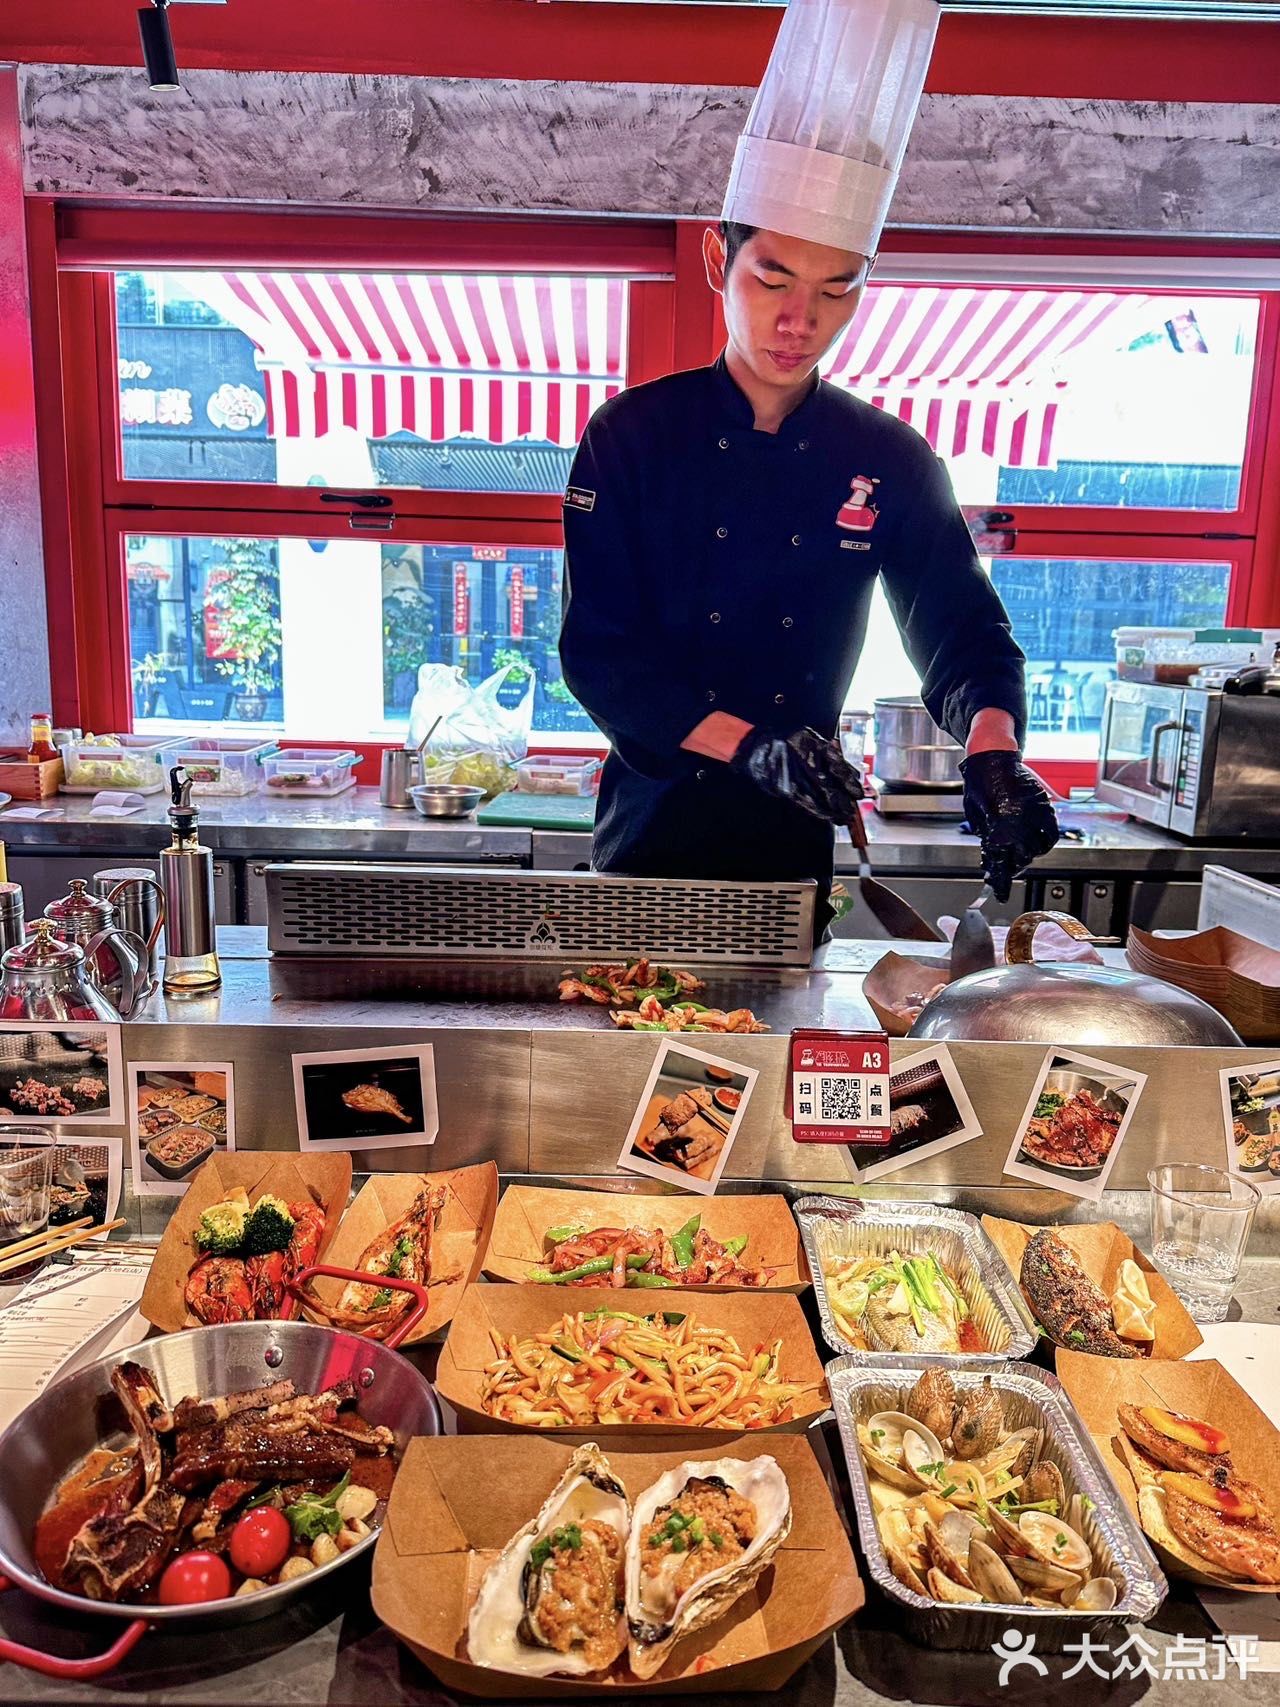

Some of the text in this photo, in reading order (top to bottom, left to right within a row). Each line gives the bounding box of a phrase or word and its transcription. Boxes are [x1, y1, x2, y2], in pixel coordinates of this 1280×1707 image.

[862, 1052, 881, 1068] A3
[800, 1083, 811, 1114] 扫码
[870, 1085, 882, 1116] 点餐
